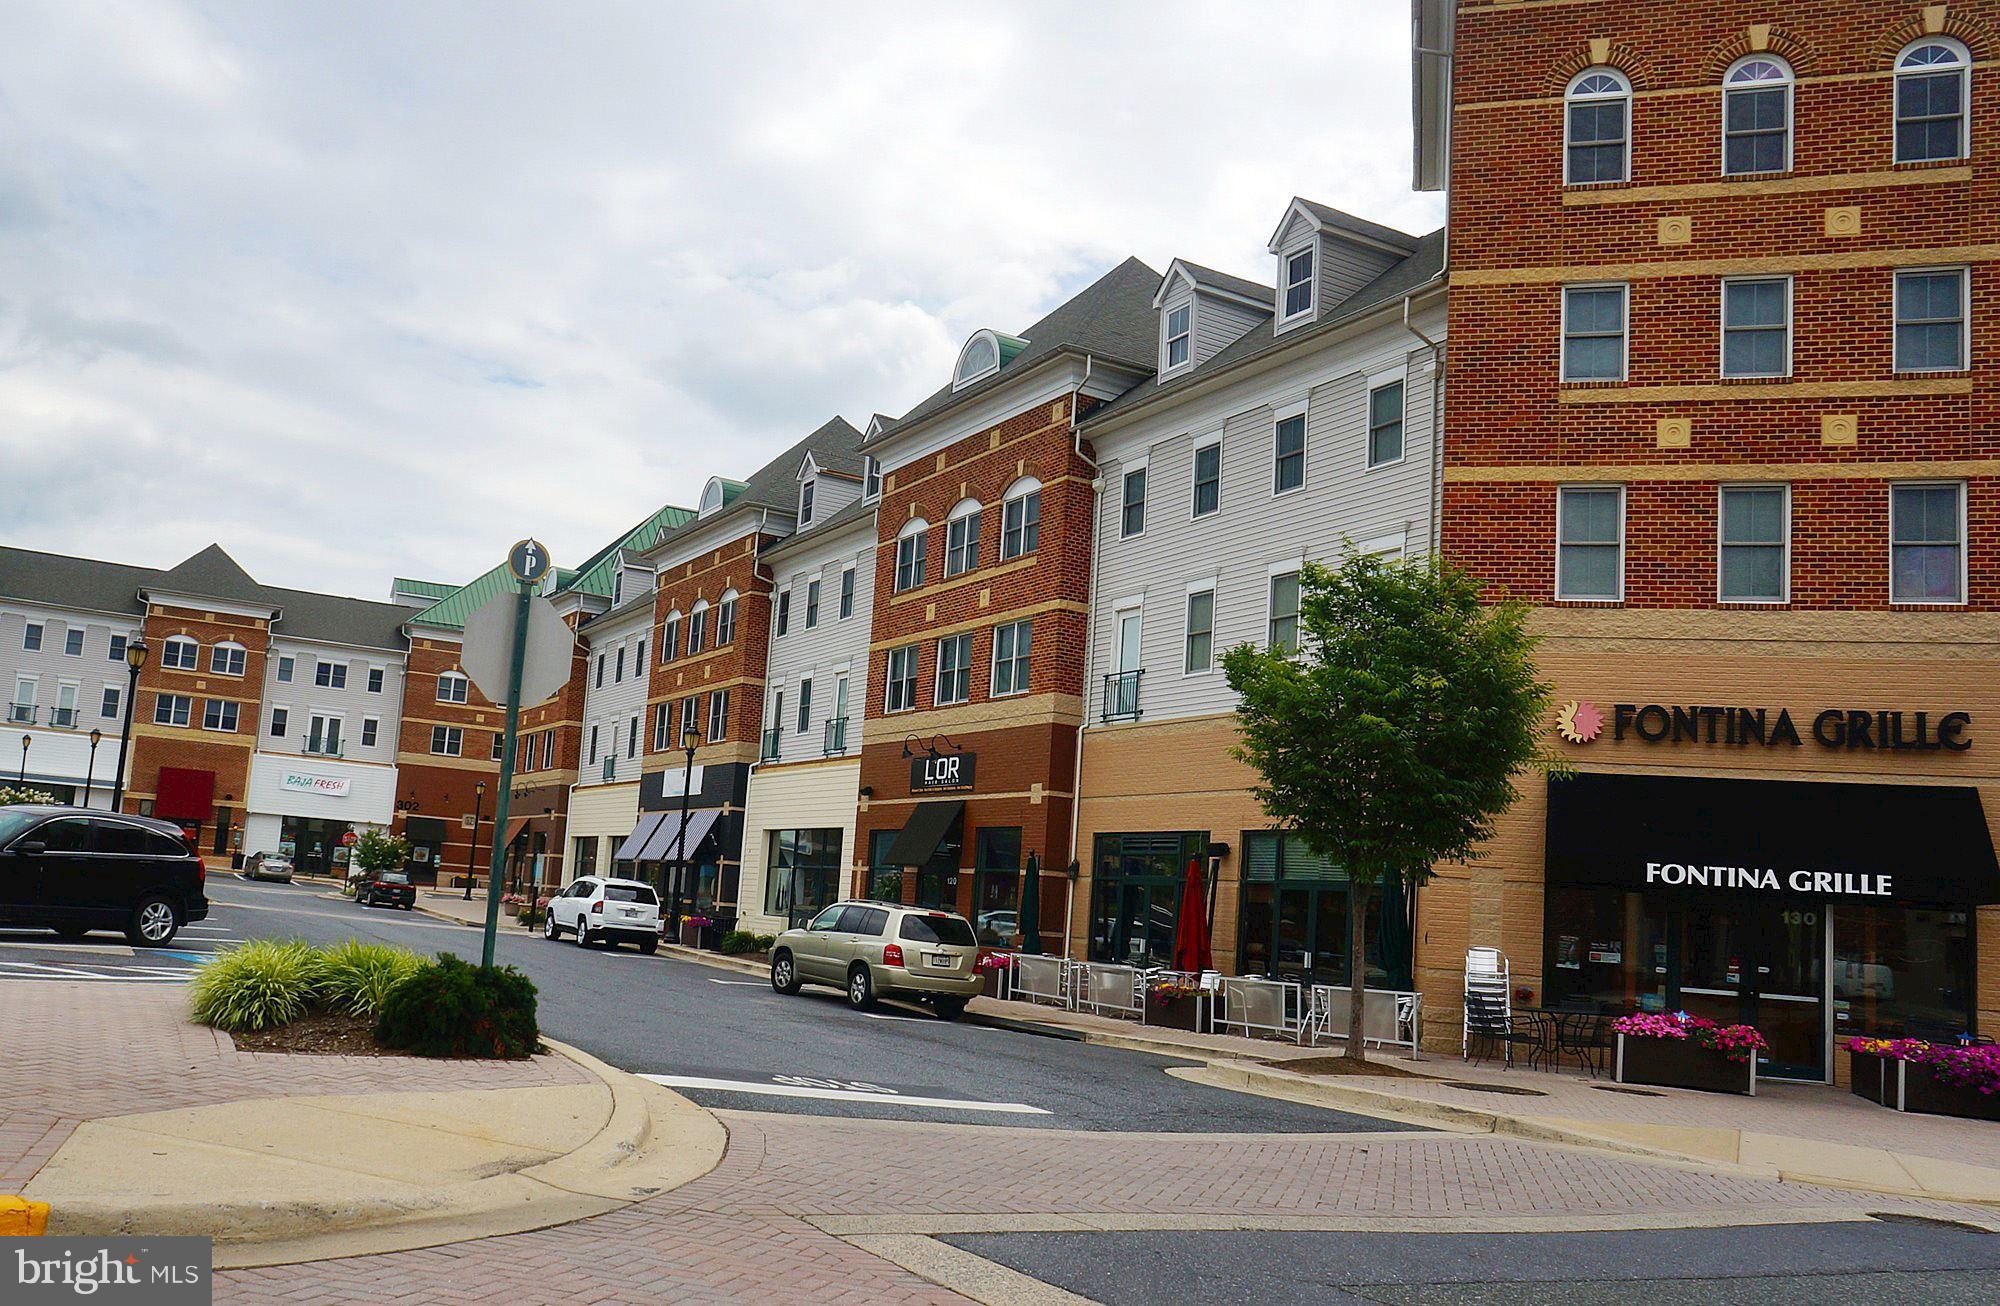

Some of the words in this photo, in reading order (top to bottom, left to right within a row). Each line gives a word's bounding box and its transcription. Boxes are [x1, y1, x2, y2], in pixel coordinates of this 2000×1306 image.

[524, 554, 537, 575] P
[1613, 703, 1804, 747] FONTINA
[1812, 708, 1974, 751] GRILLE
[286, 775, 313, 788] BAJA
[313, 779, 345, 791] FRESH
[396, 799, 420, 811] 302
[947, 877, 958, 885] 120
[1645, 861, 1781, 891] FONTINA
[1788, 869, 1893, 897] GRILLE
[1781, 911, 1817, 926] 130
